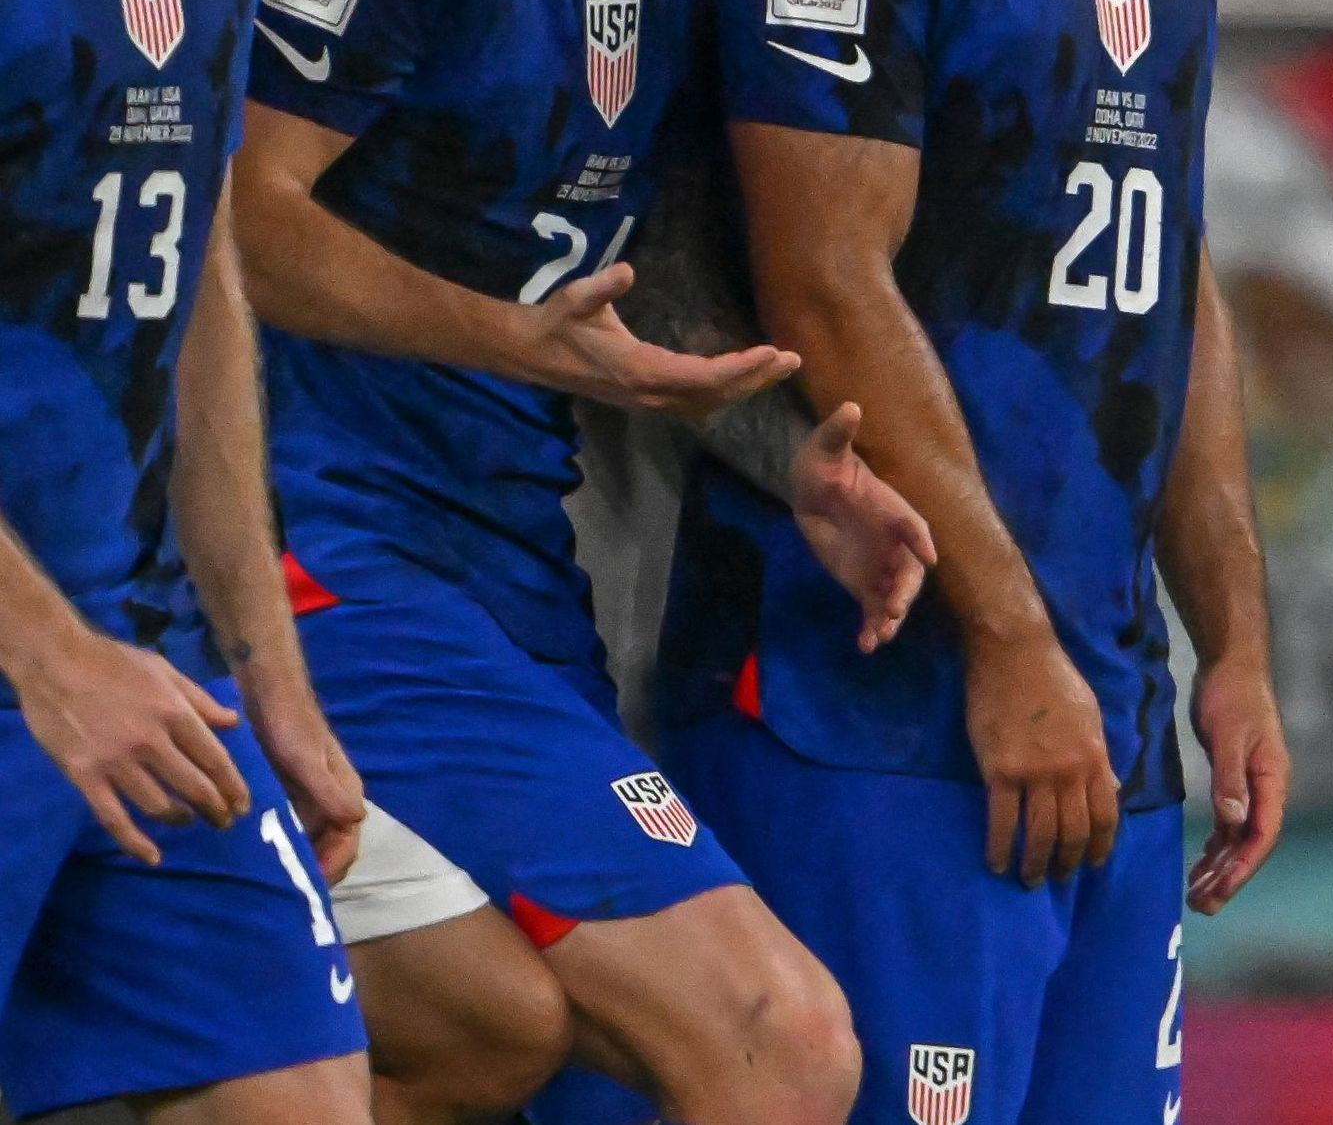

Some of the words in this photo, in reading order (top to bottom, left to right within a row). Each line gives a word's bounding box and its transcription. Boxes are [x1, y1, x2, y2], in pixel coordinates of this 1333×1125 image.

[590, 3, 637, 53] USA
[77, 171, 186, 319] 13
[1048, 161, 1163, 315] 20
[617, 775, 670, 805] USA
[260, 799, 340, 947] 1
[913, 1049, 971, 1086] USA
